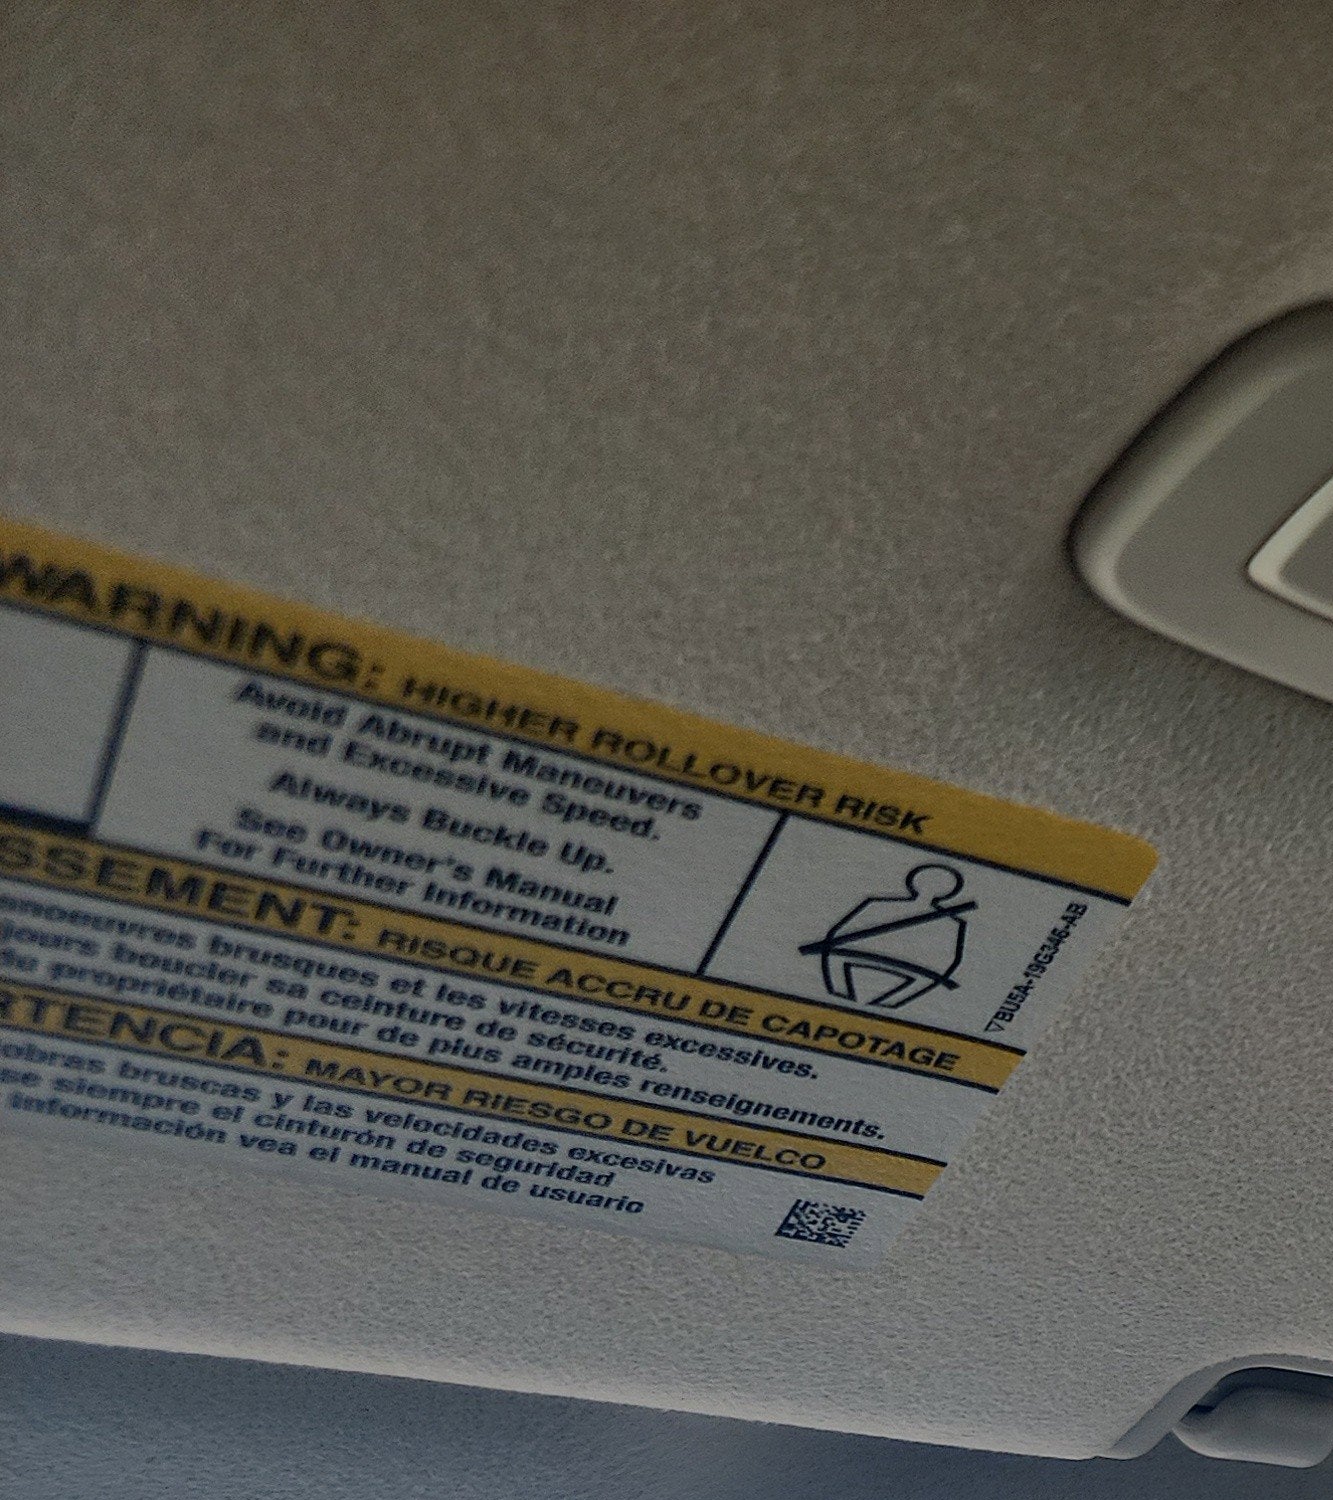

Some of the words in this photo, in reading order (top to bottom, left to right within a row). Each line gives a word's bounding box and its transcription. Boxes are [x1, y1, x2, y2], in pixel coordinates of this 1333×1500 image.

[0, 553, 385, 692] WARNING:
[400, 676, 581, 745] HIGHER
[588, 726, 826, 809] ROLLOVER
[833, 793, 934, 836] RISK
[234, 680, 348, 728] Avoid
[356, 713, 492, 766] Abrupt
[500, 749, 703, 821] Maneuvers
[254, 722, 333, 756] and
[341, 739, 531, 807] Excessive
[540, 791, 660, 841] Speed.
[268, 770, 411, 824] Always
[421, 806, 550, 858] Buckle
[558, 841, 614, 874] Up.
[196, 828, 259, 860] For
[270, 845, 415, 896] Further
[422, 881, 631, 947] Information
[236, 807, 308, 844] See
[319, 828, 475, 882] Owner's
[483, 865, 619, 916] Manual
[49, 962, 274, 1018] propriétaire
[282, 1007, 370, 1036] pour
[375, 1025, 420, 1047] de
[426, 1037, 503, 1064] plus
[509, 1053, 632, 1089] amples
[639, 1079, 886, 1140] renseignements.
[110, 941, 258, 988] boucler
[265, 978, 309, 1000] sa
[318, 989, 467, 1031] ceinture
[474, 1019, 518, 1042] de
[526, 1031, 668, 1073] sécurité.
[207, 934, 380, 988] brusques
[388, 977, 427, 998] et
[434, 982, 488, 1011] les
[498, 999, 637, 1041] vitesses
[643, 1031, 818, 1080] excessives.
[376, 928, 540, 980] RISQUE
[544, 967, 692, 1012] ACCRU
[697, 998, 755, 1027] DE
[760, 1013, 961, 1072] CAPOTAGE
[9, 1092, 227, 1144] información
[239, 1133, 298, 1157] vea
[307, 1146, 342, 1163] el
[348, 1153, 474, 1186] manual
[480, 1173, 521, 1194] de
[528, 1183, 645, 1214] usuario
[52, 1077, 201, 1115] siempre
[211, 1105, 245, 1123] el
[253, 1113, 397, 1150] cinturón
[405, 1138, 448, 1159] de
[455, 1149, 617, 1188] seguridad
[117, 1060, 261, 1103] bruscas
[271, 1092, 295, 1110] y
[302, 1093, 355, 1119] las
[364, 1108, 559, 1156] velocidades
[567, 1146, 716, 1184] excesivas
[304, 1058, 453, 1101] MAYOR
[461, 1088, 613, 1131] RIESGO
[620, 1118, 676, 1142] DE
[685, 1129, 827, 1171] VUELCO
